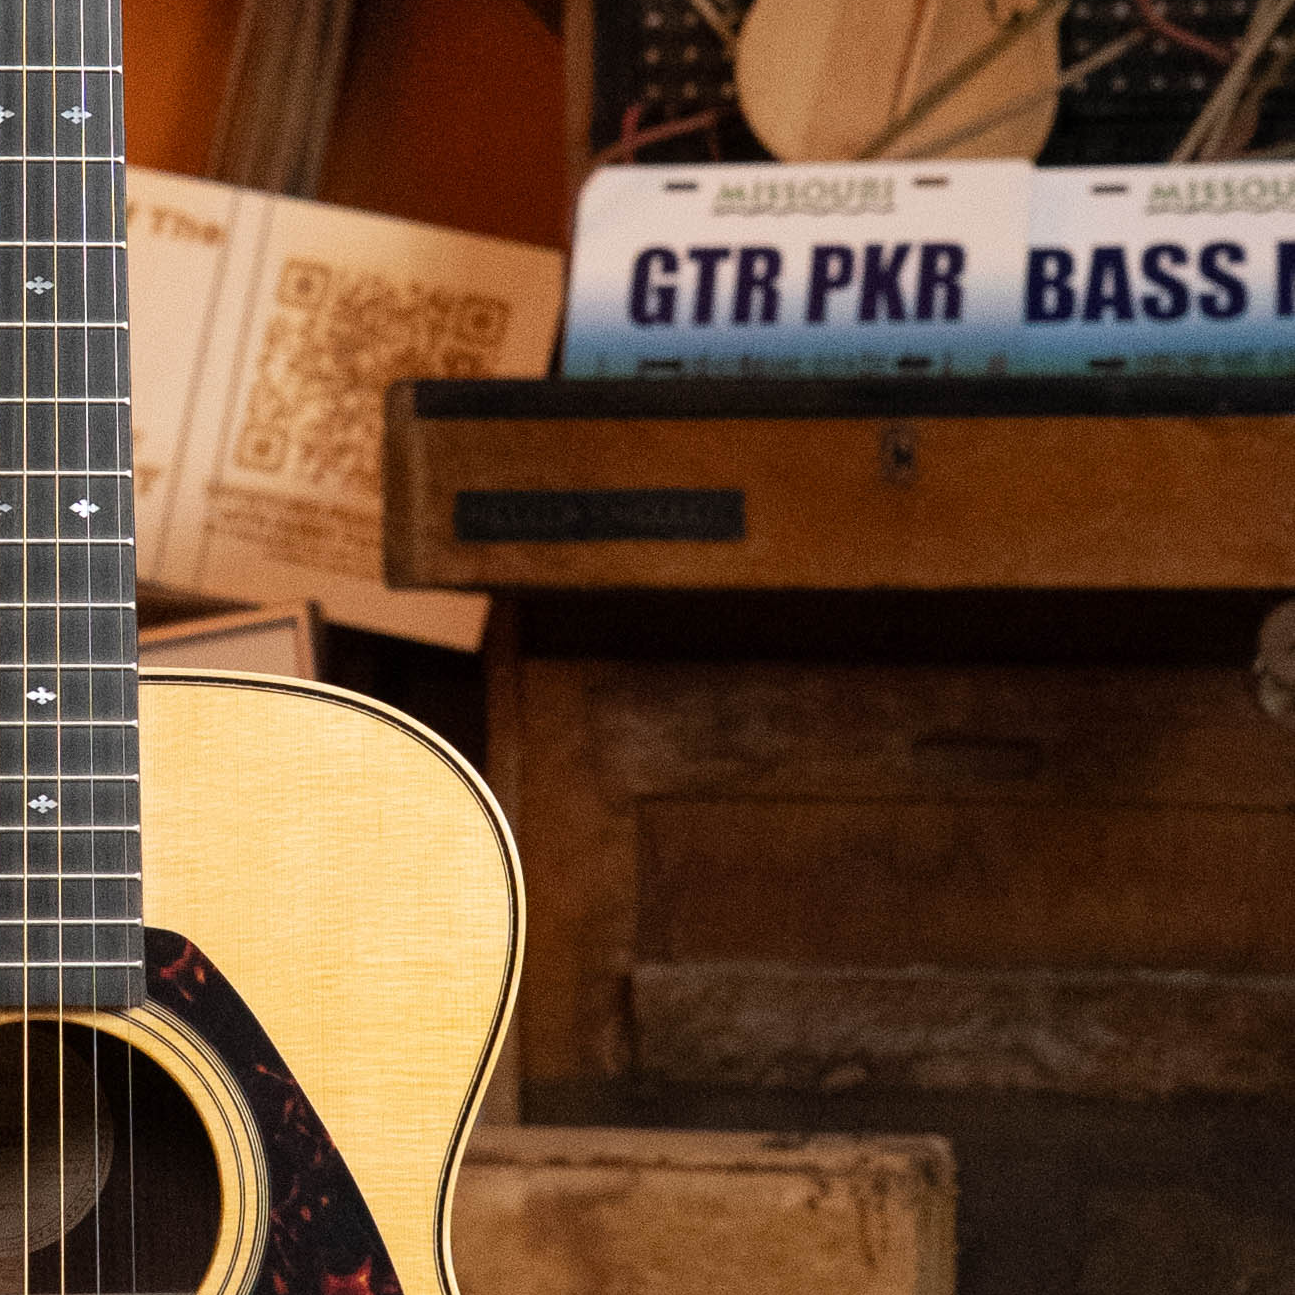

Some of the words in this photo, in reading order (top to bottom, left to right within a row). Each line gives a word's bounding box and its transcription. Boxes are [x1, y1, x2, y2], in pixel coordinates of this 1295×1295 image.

[713, 176, 897, 209] MISSOURI
[628, 243, 783, 326] GTR
[806, 241, 967, 324] PKR
[1022, 240, 1249, 324] BASS
